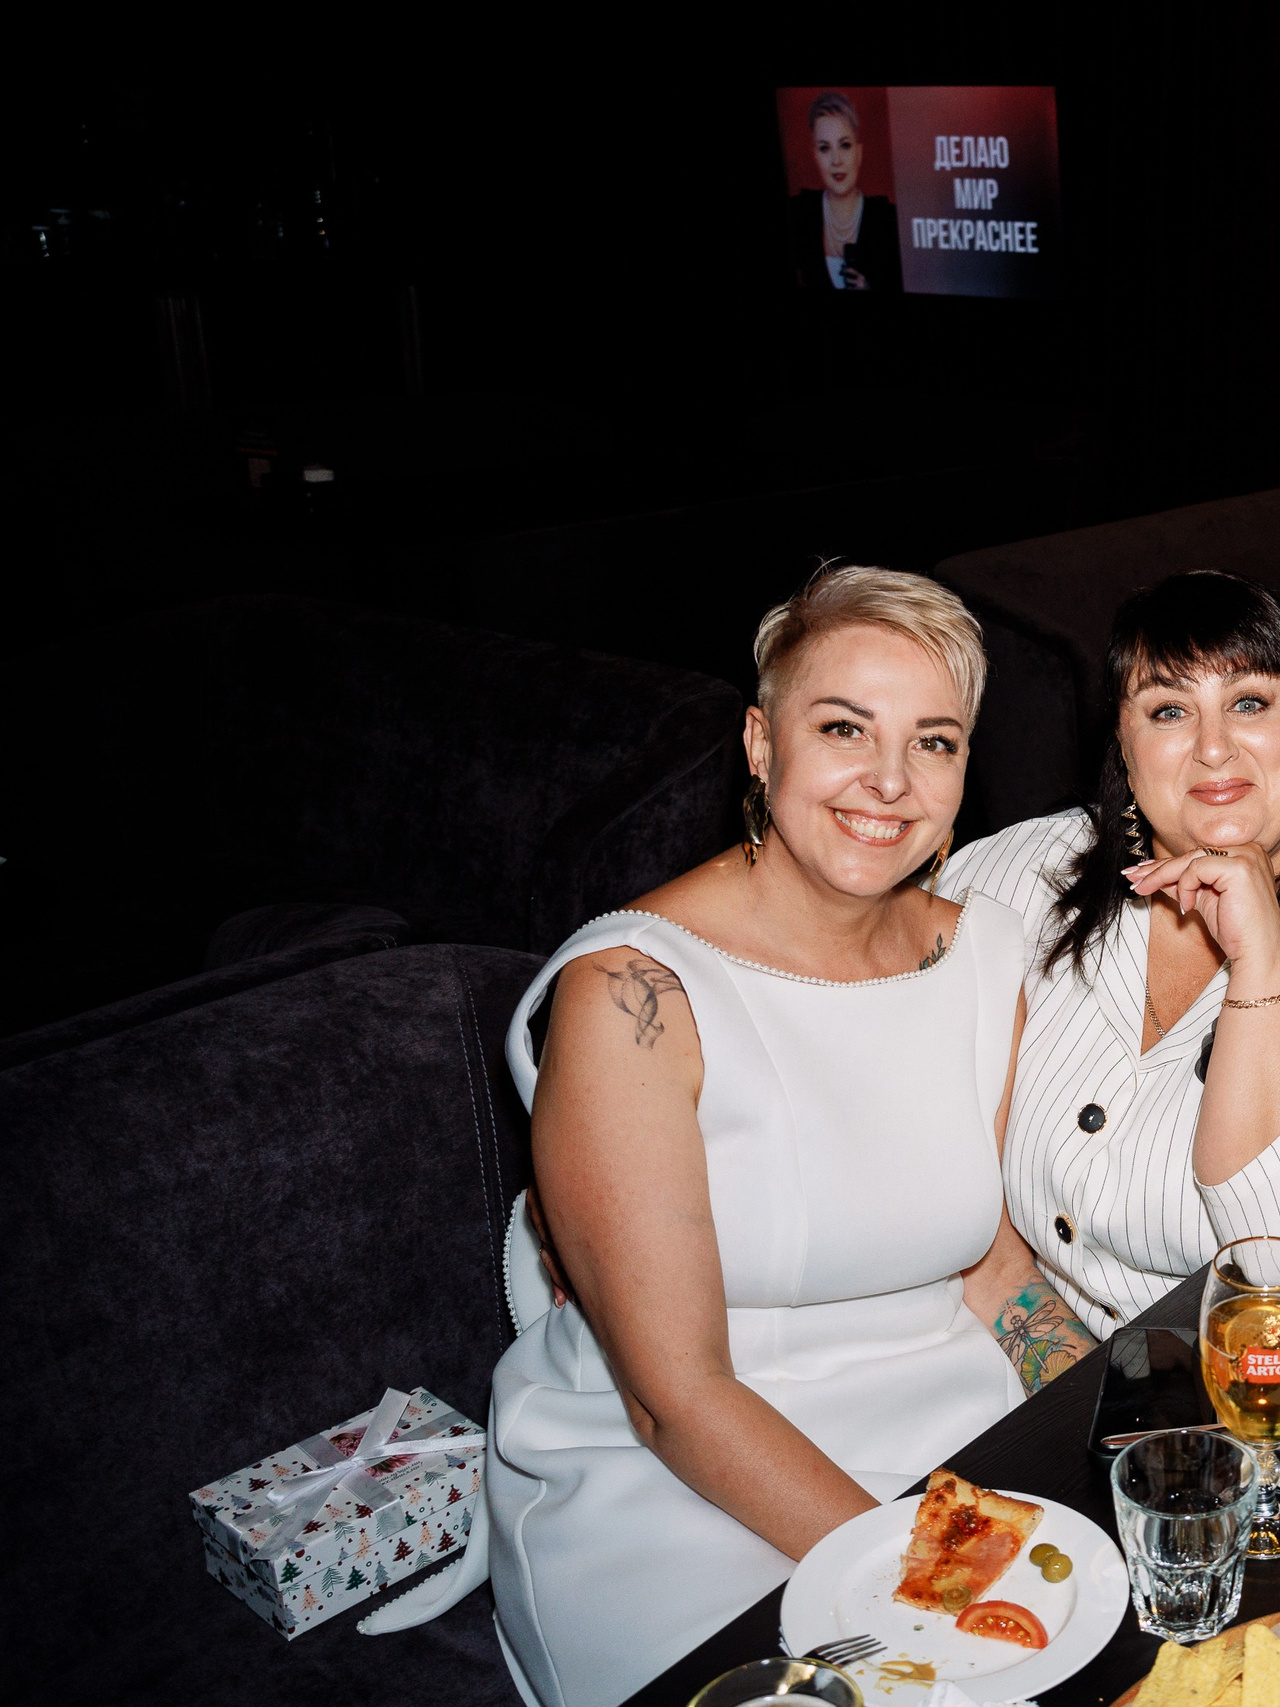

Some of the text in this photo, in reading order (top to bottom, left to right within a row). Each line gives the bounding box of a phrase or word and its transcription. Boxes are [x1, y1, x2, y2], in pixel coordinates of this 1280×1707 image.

[934, 136, 1009, 170] ДЕЛАЮ
[953, 178, 999, 211] МИР
[912, 218, 1039, 253] ПРЕКРАСНЕЕ
